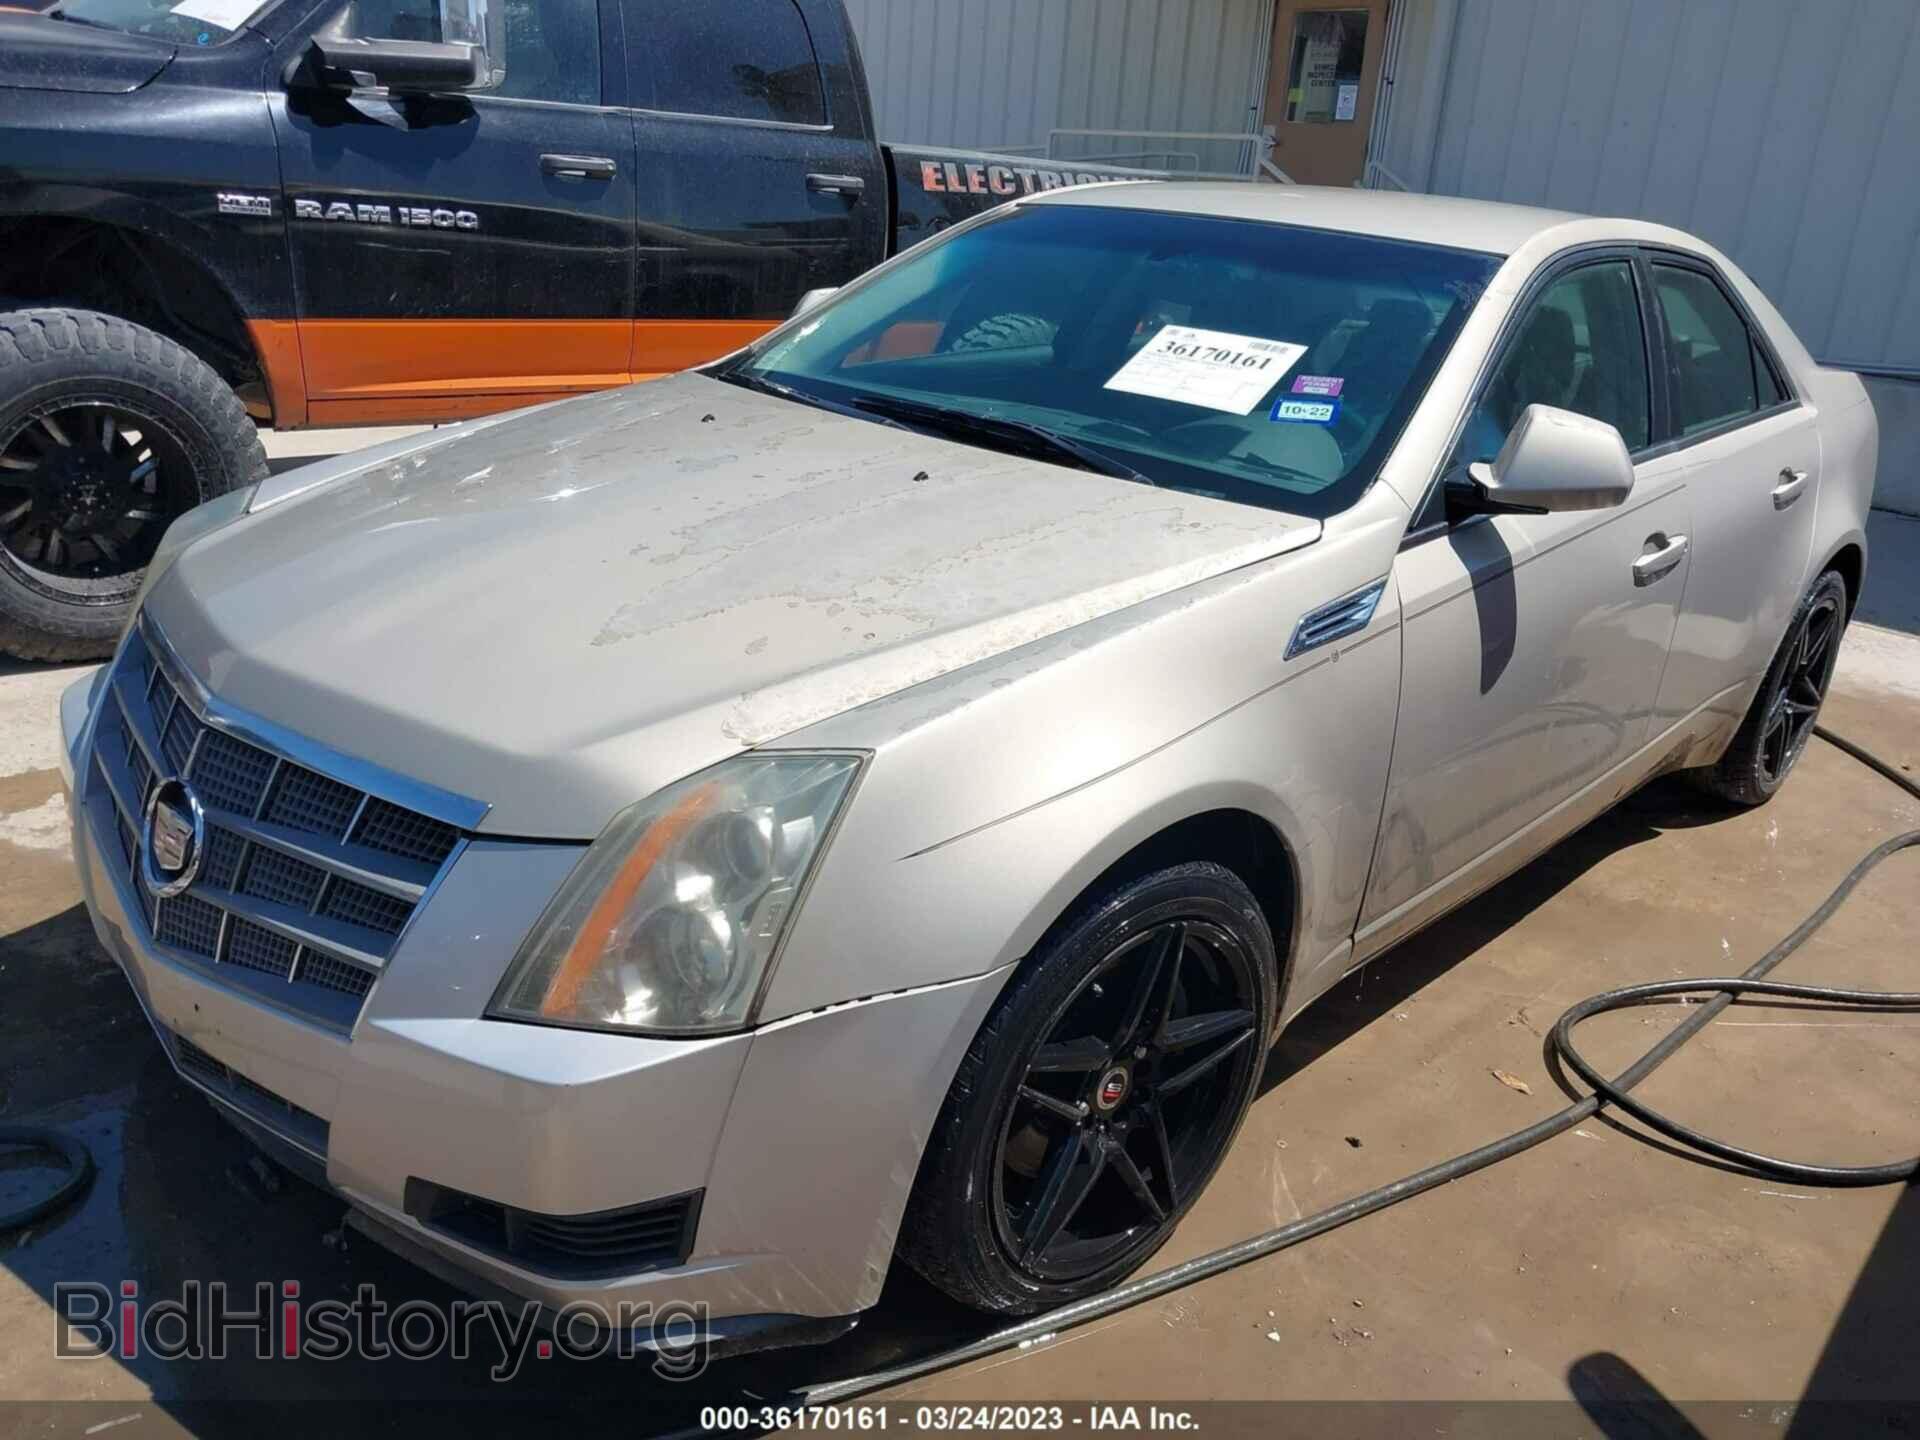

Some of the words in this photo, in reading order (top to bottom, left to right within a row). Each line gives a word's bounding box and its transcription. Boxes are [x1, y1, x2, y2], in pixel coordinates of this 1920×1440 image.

[295, 199, 392, 224] RAM
[398, 206, 479, 230] 1500
[1157, 340, 1272, 370] 36170161
